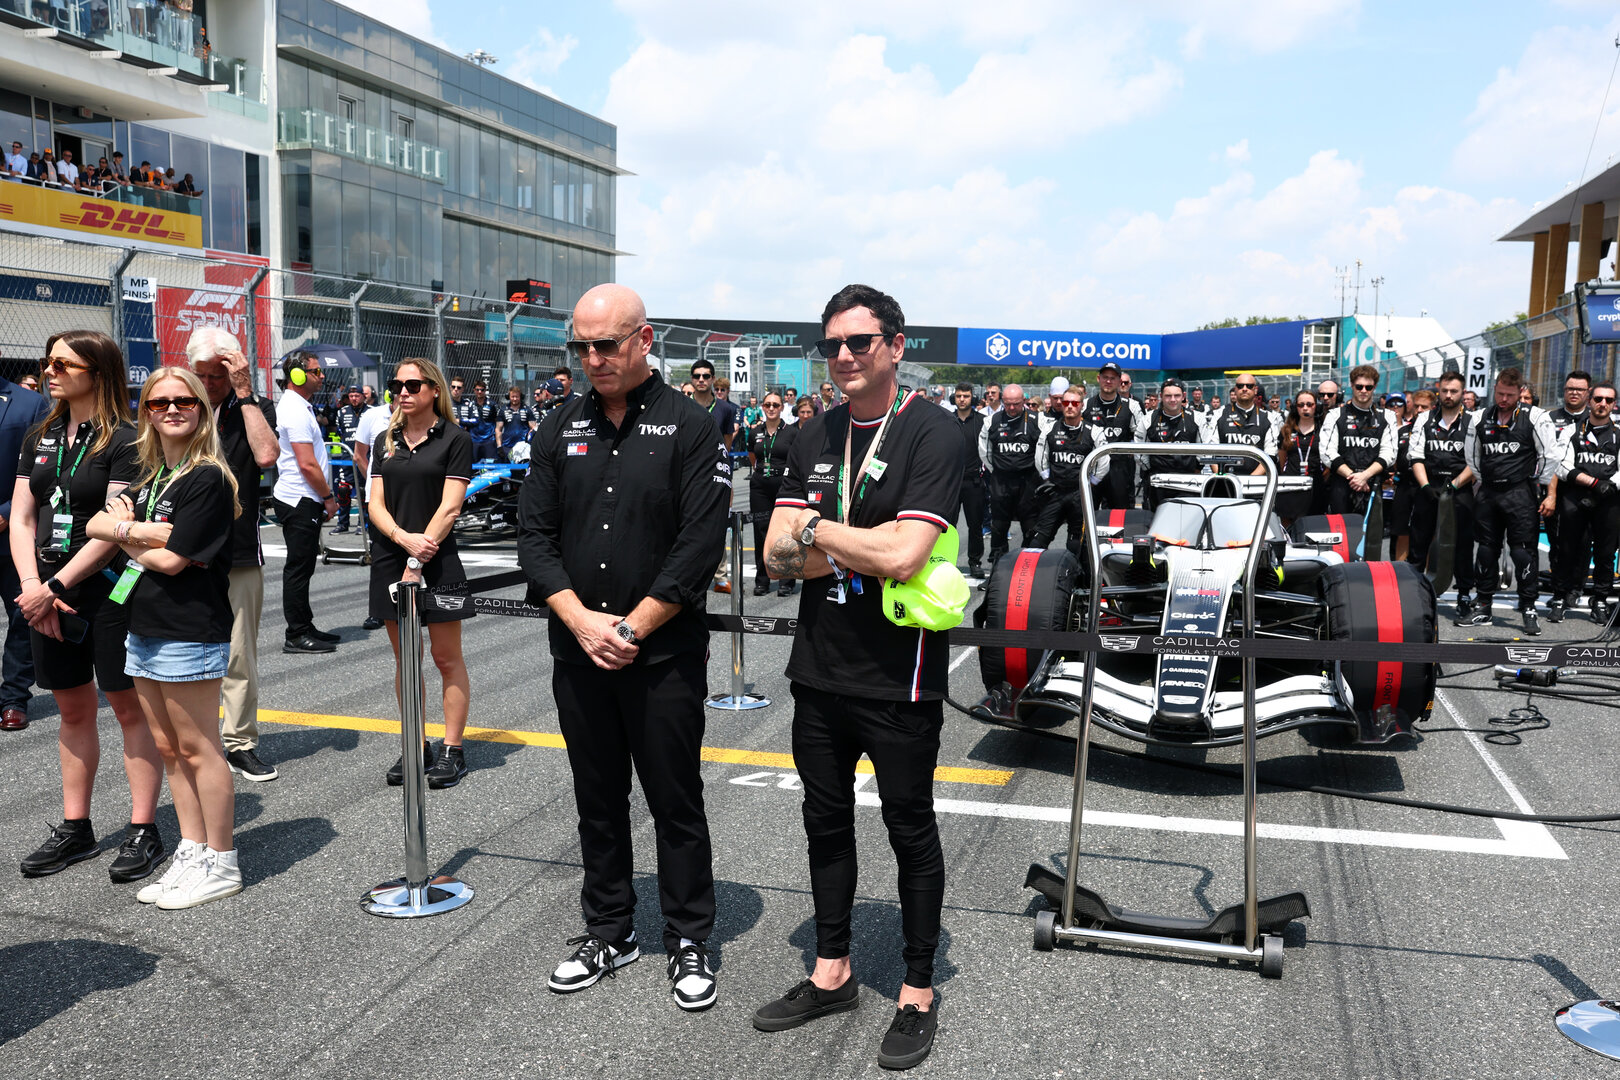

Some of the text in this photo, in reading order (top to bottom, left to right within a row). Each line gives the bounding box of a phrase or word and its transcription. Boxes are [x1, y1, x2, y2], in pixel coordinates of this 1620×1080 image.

[79, 201, 170, 239] DHL
[130, 278, 149, 288] MP
[122, 290, 155, 299] FINISH
[1017, 338, 1151, 360] crypto.com
[735, 355, 746, 368] S
[1473, 356, 1485, 370] S
[734, 371, 748, 384] M
[1469, 374, 1486, 388] M
[638, 423, 666, 435] TWG
[1225, 433, 1250, 444] TWG
[1343, 436, 1369, 448] TWG
[998, 443, 1021, 453] TWG
[1427, 440, 1454, 452] TWG
[1483, 441, 1509, 455] TWG
[1052, 451, 1076, 463] TWG
[1577, 452, 1605, 464] TWG
[430, 581, 468, 595] CADILLAC
[1014, 578, 1026, 607] FRONT
[1152, 636, 1240, 648] CADILLAC
[1152, 647, 1201, 655] FORMULA
[1160, 680, 1206, 690] TENNECO
[1384, 671, 1394, 701] FRONT
